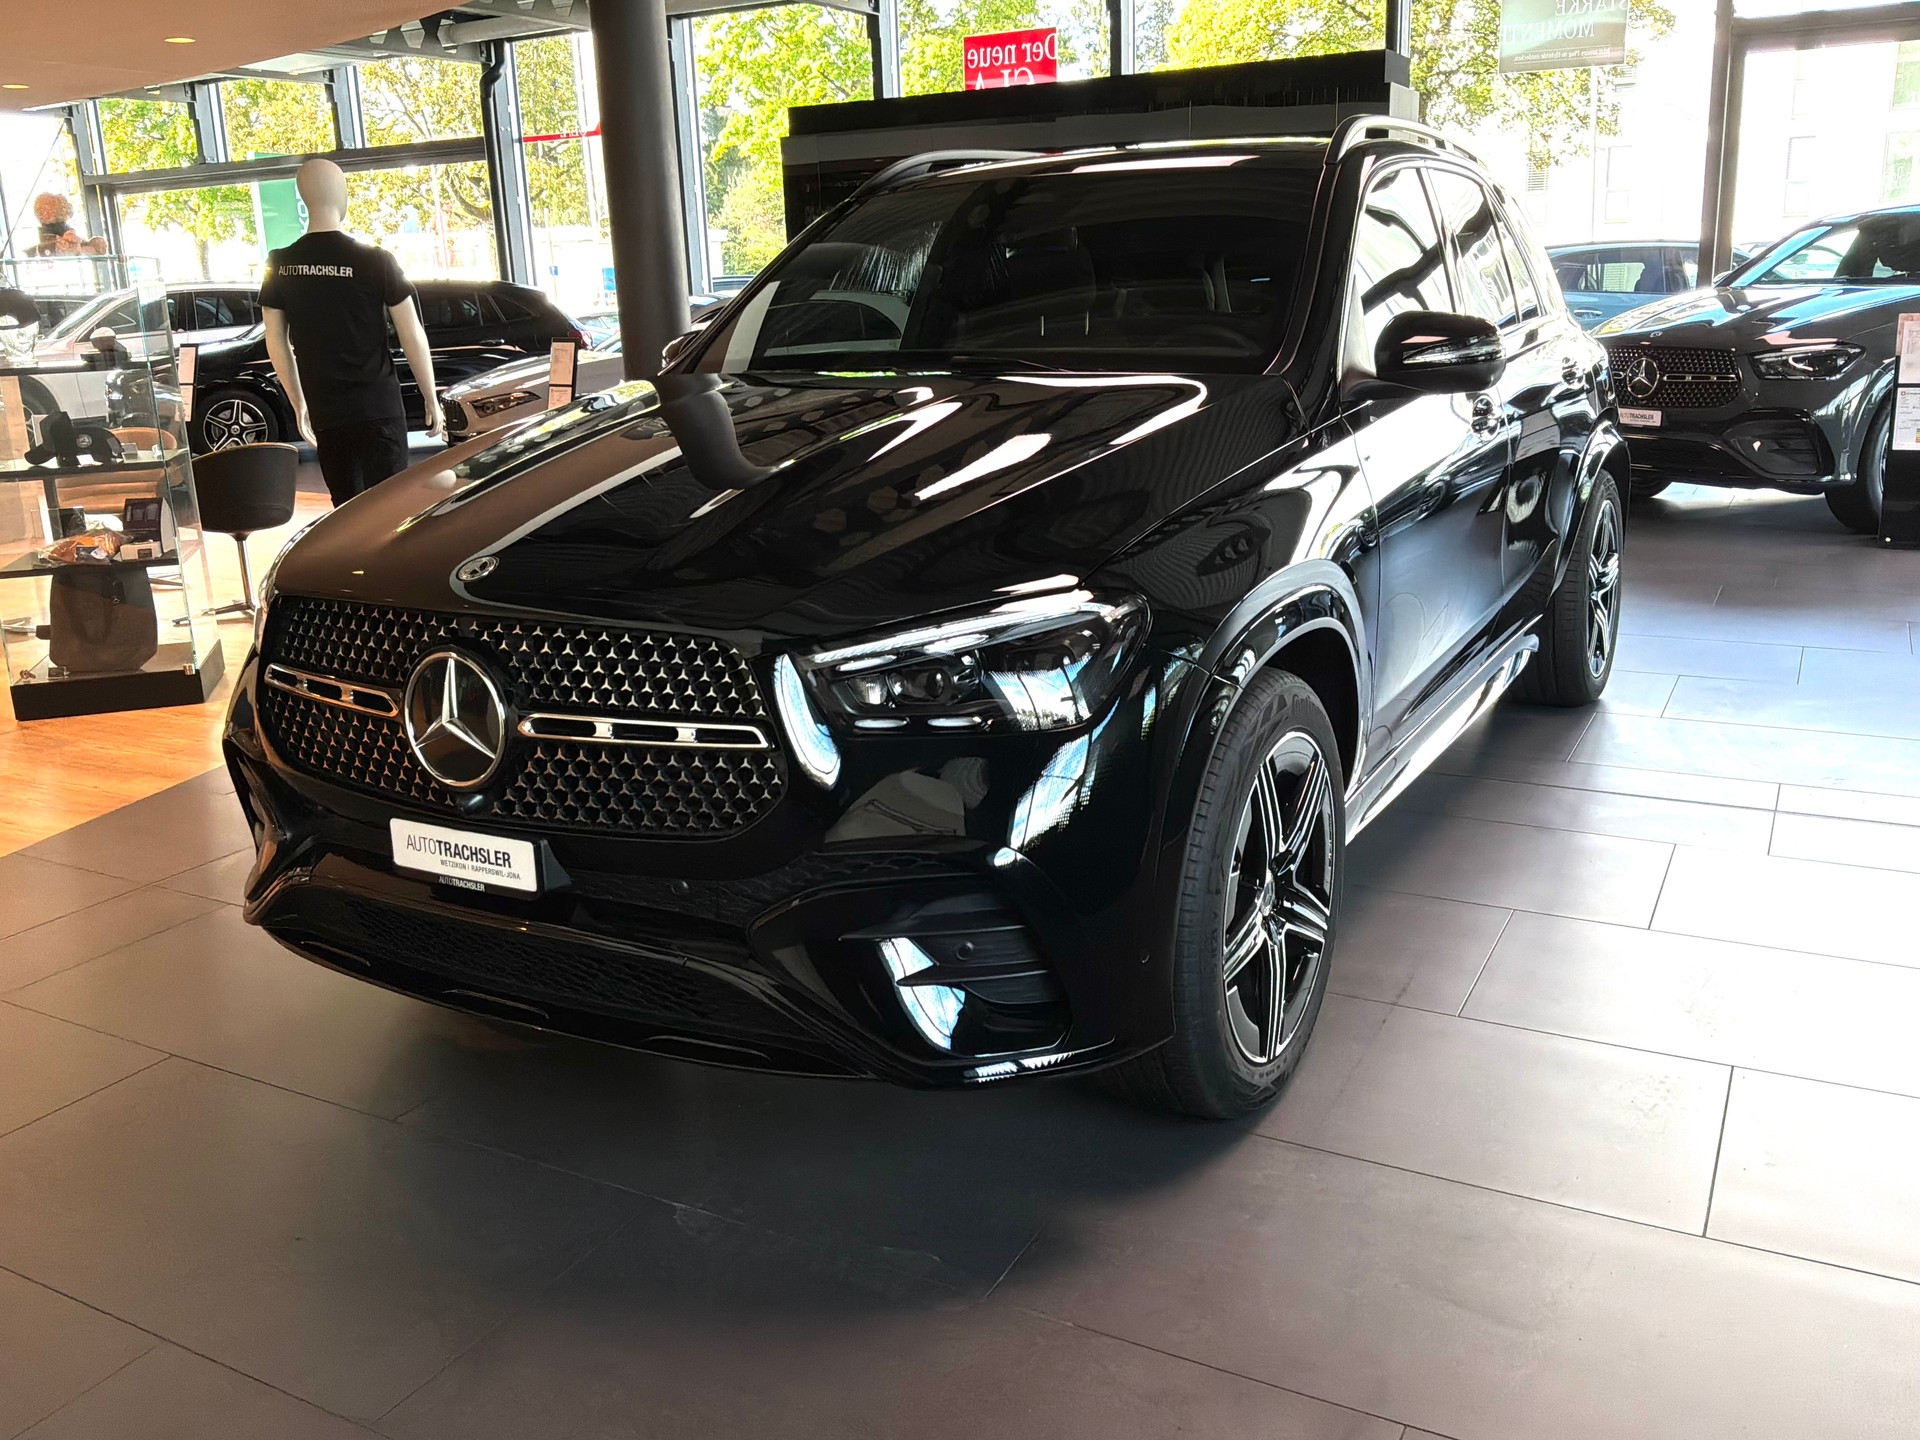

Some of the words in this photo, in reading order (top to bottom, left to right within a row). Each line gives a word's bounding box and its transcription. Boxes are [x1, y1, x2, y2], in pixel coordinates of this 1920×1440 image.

[278, 264, 354, 278] AUTOTRACHSLER
[406, 834, 512, 869] AUTOTRACHSLER
[440, 859, 467, 871] WETZIKON
[471, 864, 521, 881] RAPPERSWIL-JONA
[438, 875, 486, 893] AUTOTRACHSLER
